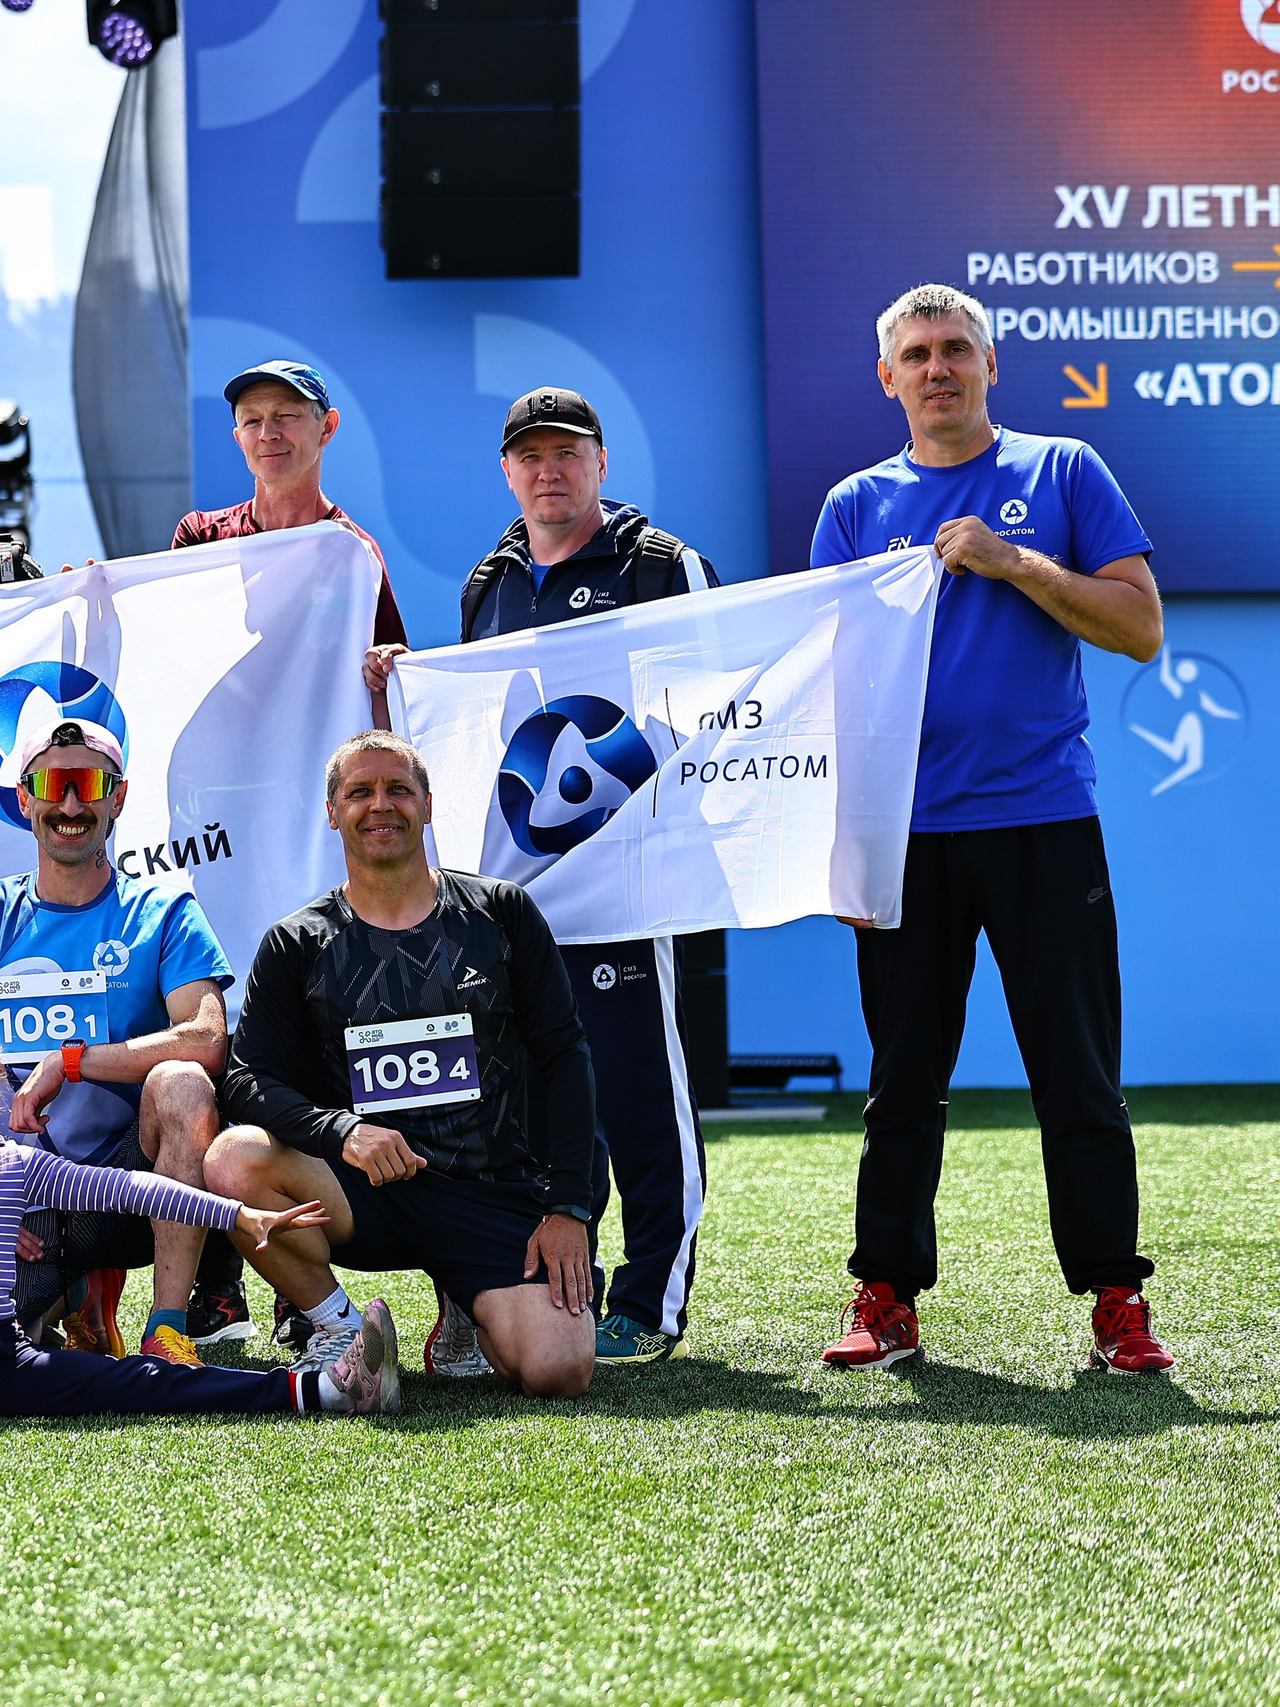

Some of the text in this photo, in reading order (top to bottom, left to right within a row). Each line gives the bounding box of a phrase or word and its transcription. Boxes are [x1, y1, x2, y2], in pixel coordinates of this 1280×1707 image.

[1222, 69, 1280, 93] РОС
[1054, 184, 1130, 230] XV
[966, 251, 1221, 286] РАБОТНИКОВ
[1133, 362, 1280, 407] «АТО
[680, 754, 828, 786] РОСАТОМ
[456, 977, 488, 990] DEMIX
[84, 1014, 97, 1038] 1
[353, 1050, 471, 1093] 108 4
